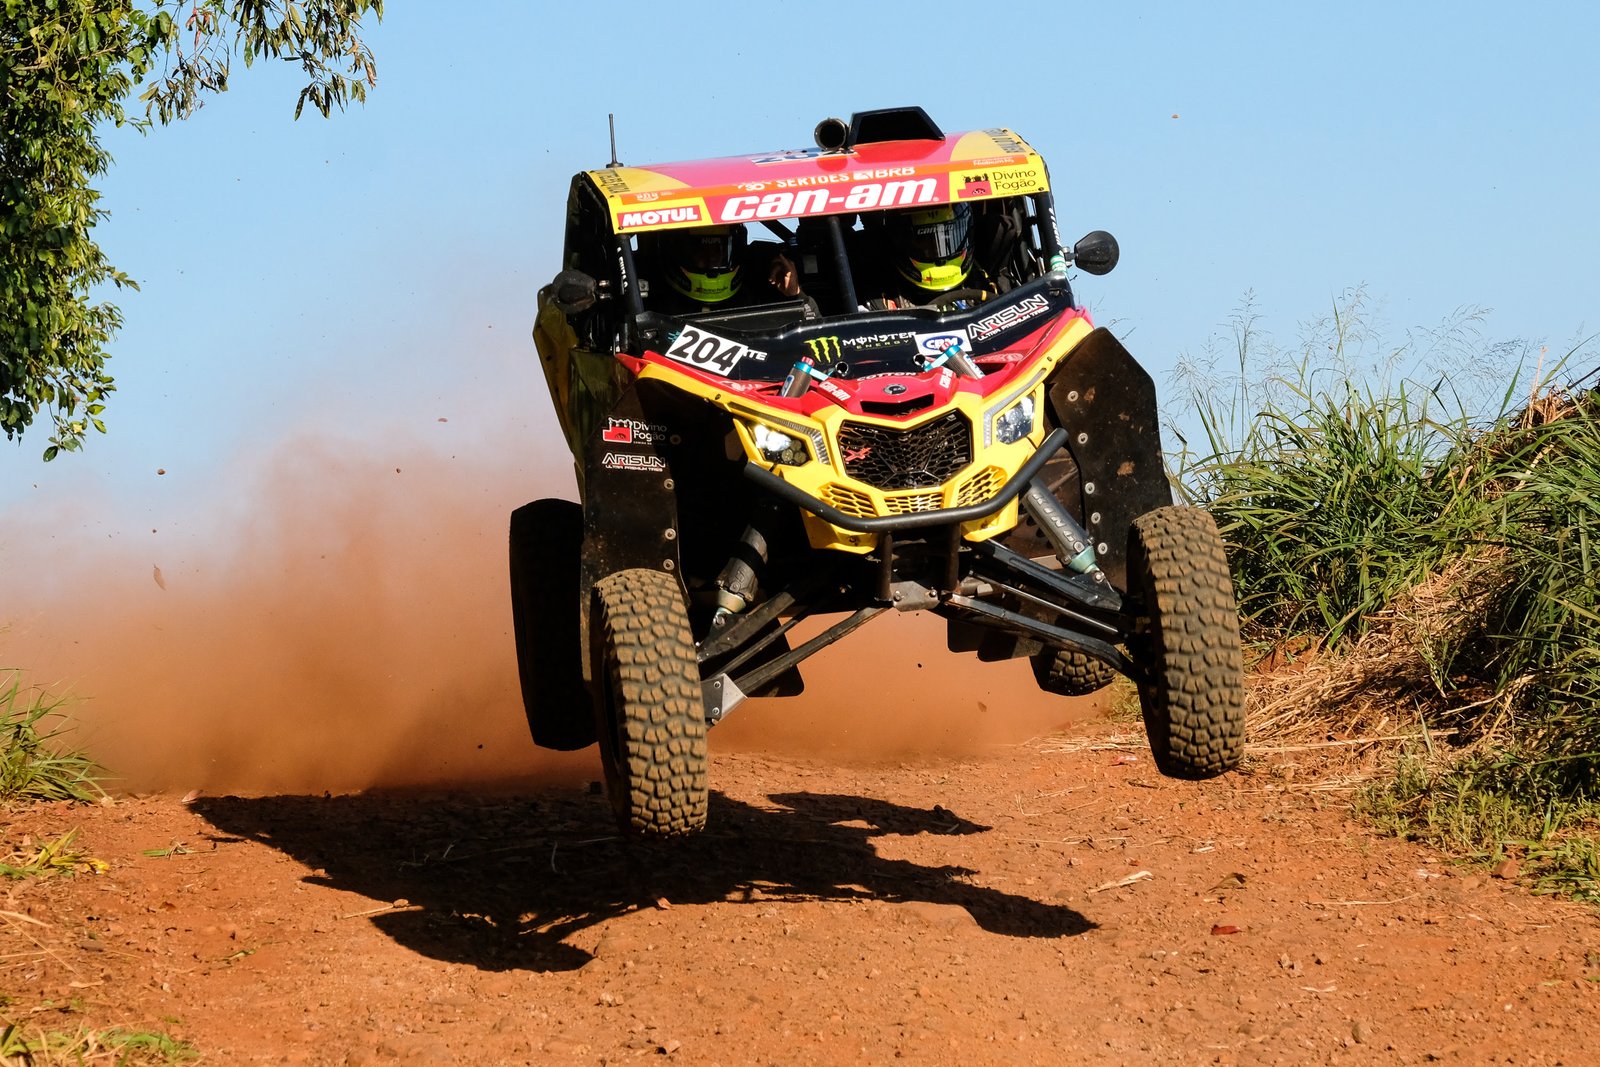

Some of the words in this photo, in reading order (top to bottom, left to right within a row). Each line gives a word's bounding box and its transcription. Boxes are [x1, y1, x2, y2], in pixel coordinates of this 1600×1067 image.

[992, 170, 1036, 181] Divino
[994, 179, 1036, 191] Fogão
[721, 178, 938, 221] can-am
[622, 207, 698, 227] MOTUL
[967, 293, 1049, 340] ARISUN
[1001, 314, 1031, 331] PREMIUM
[842, 331, 917, 347] MONSTER
[856, 339, 909, 350] ENERGY
[669, 330, 741, 372] 204
[633, 420, 667, 432] Divino
[633, 430, 666, 442] Fogão
[602, 452, 666, 468] ARISUN
